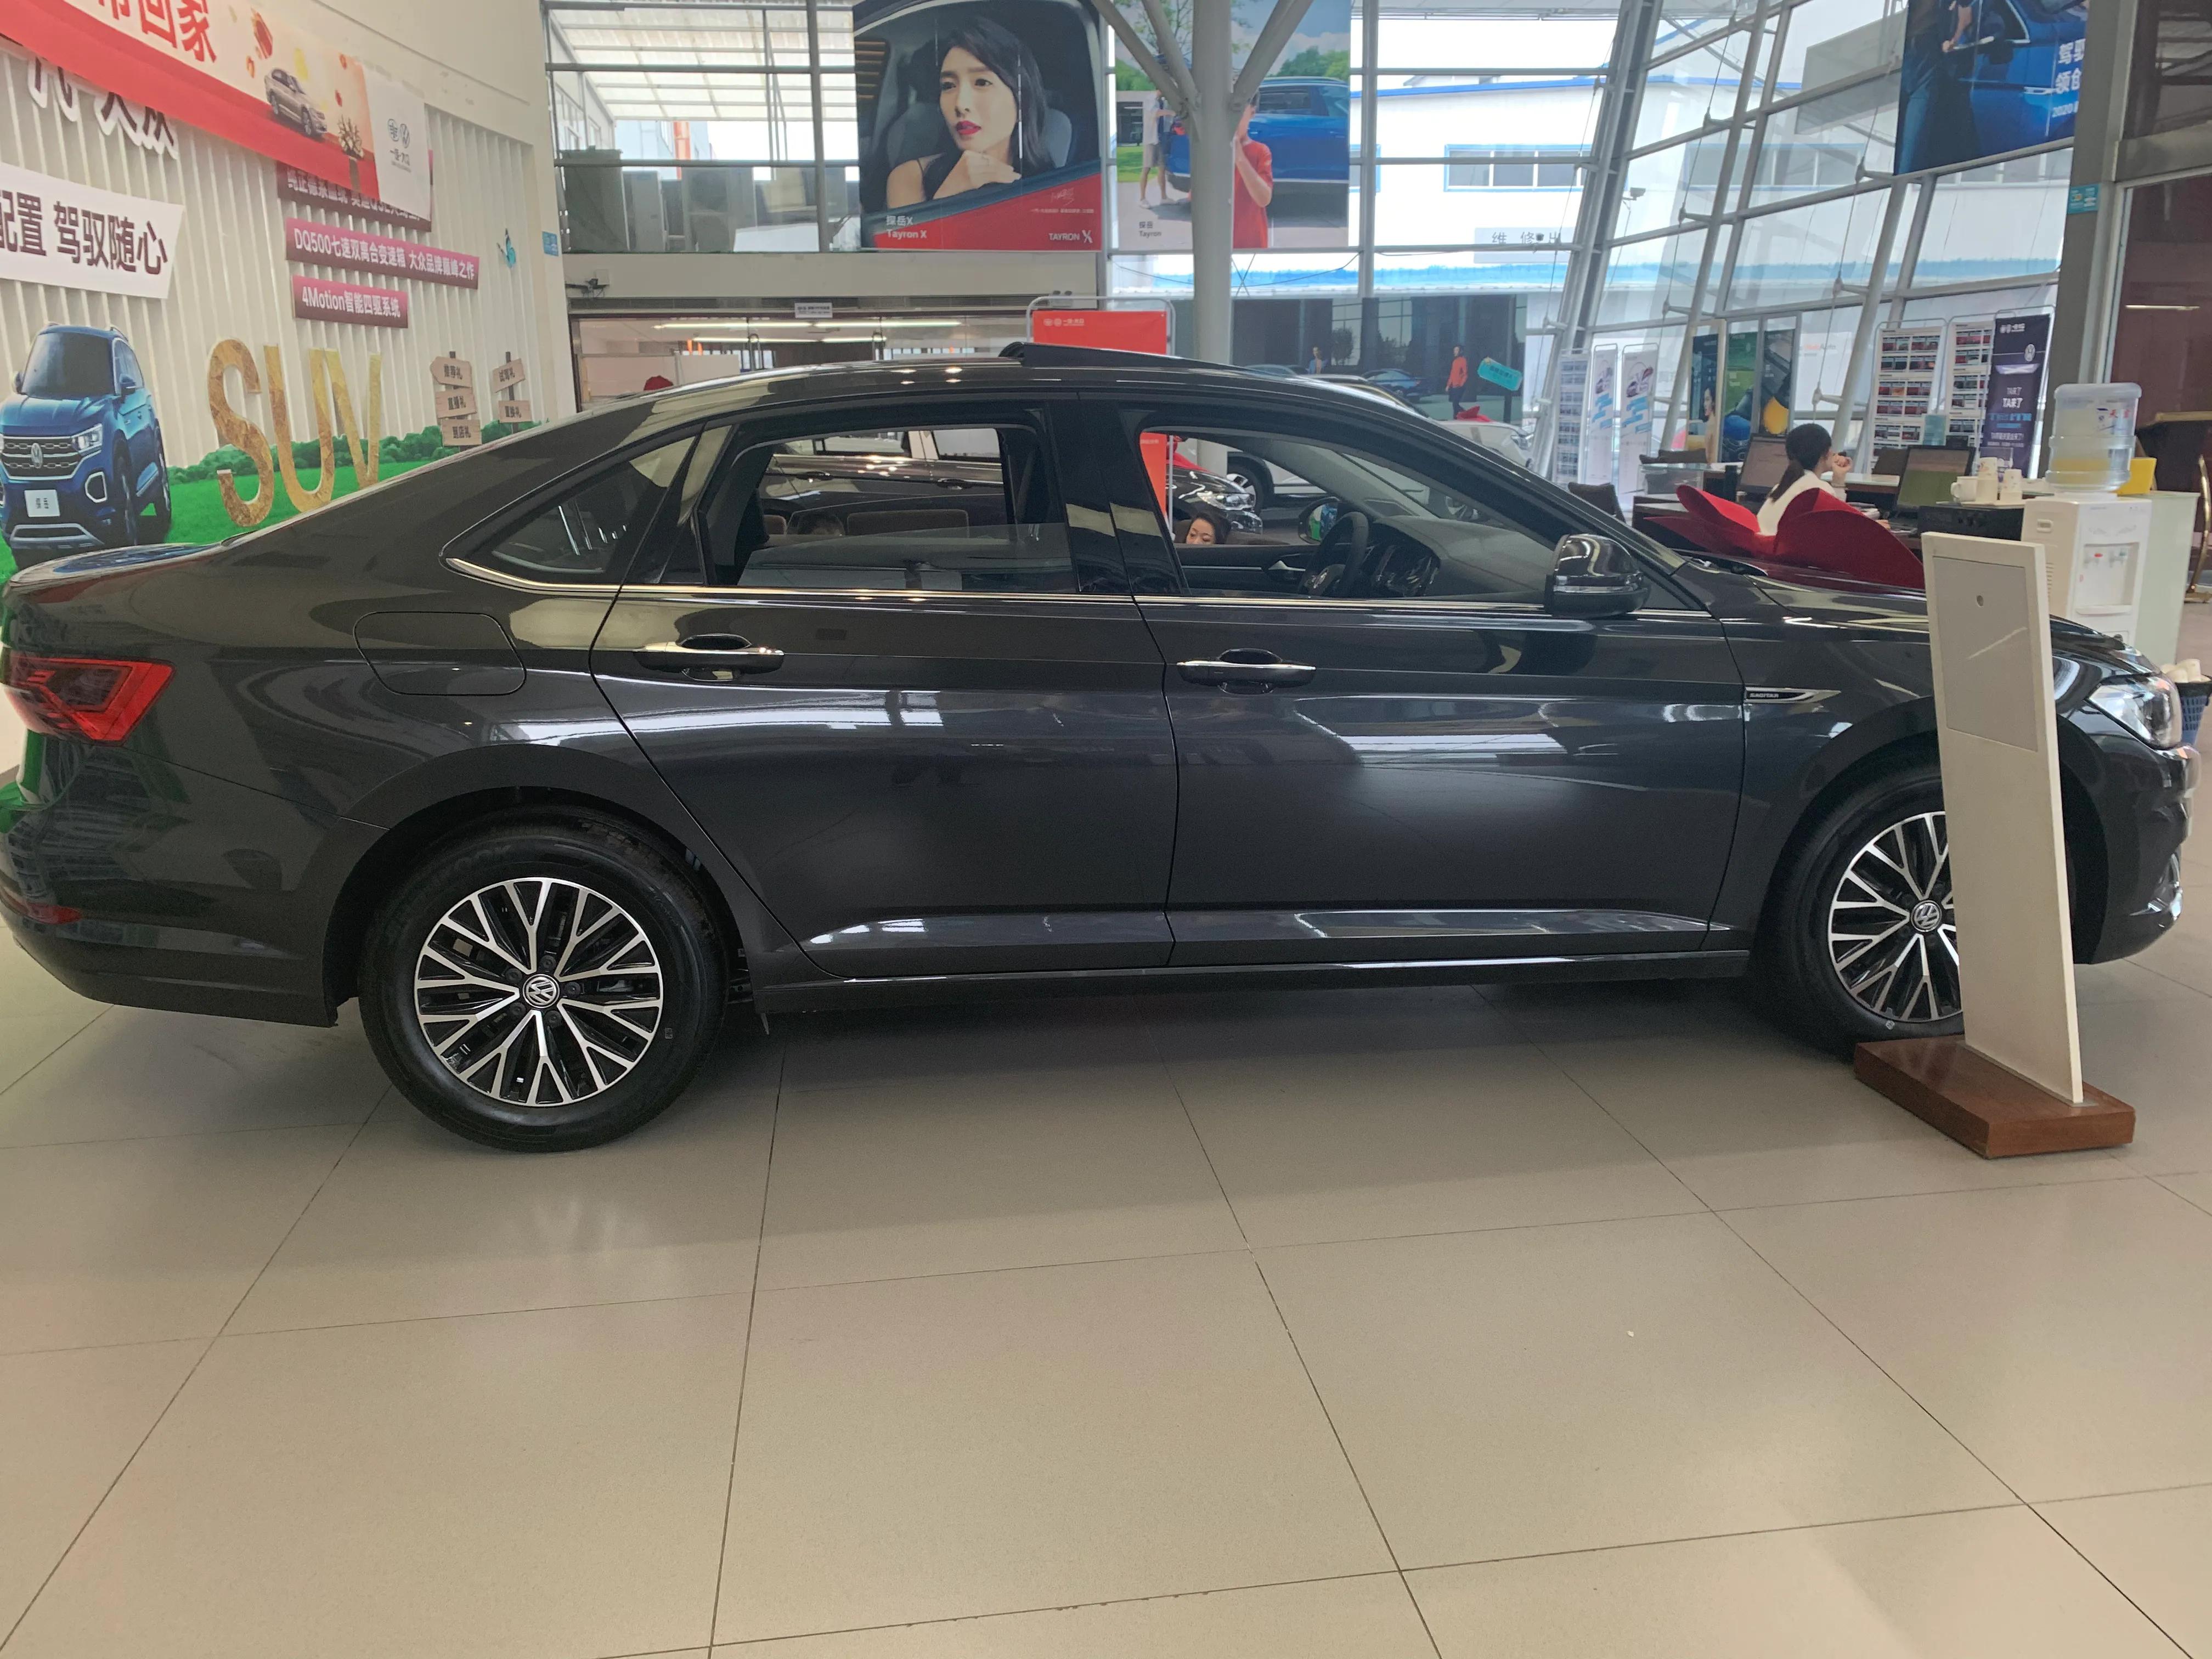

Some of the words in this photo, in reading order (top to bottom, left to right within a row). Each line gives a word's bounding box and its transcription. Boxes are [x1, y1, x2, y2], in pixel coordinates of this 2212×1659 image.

[53, 201, 168, 275] 驾驭随心
[294, 228, 407, 268] DQ500七速双离合变速箱
[409, 252, 475, 280] 大众品牌巅峰之作
[886, 229, 918, 240] Tayron
[919, 230, 927, 238] X
[1048, 233, 1080, 241] TAYRON
[1082, 229, 1093, 243] X
[302, 286, 401, 318] 4Motion智能四驱系统
[207, 337, 382, 527] SUV
